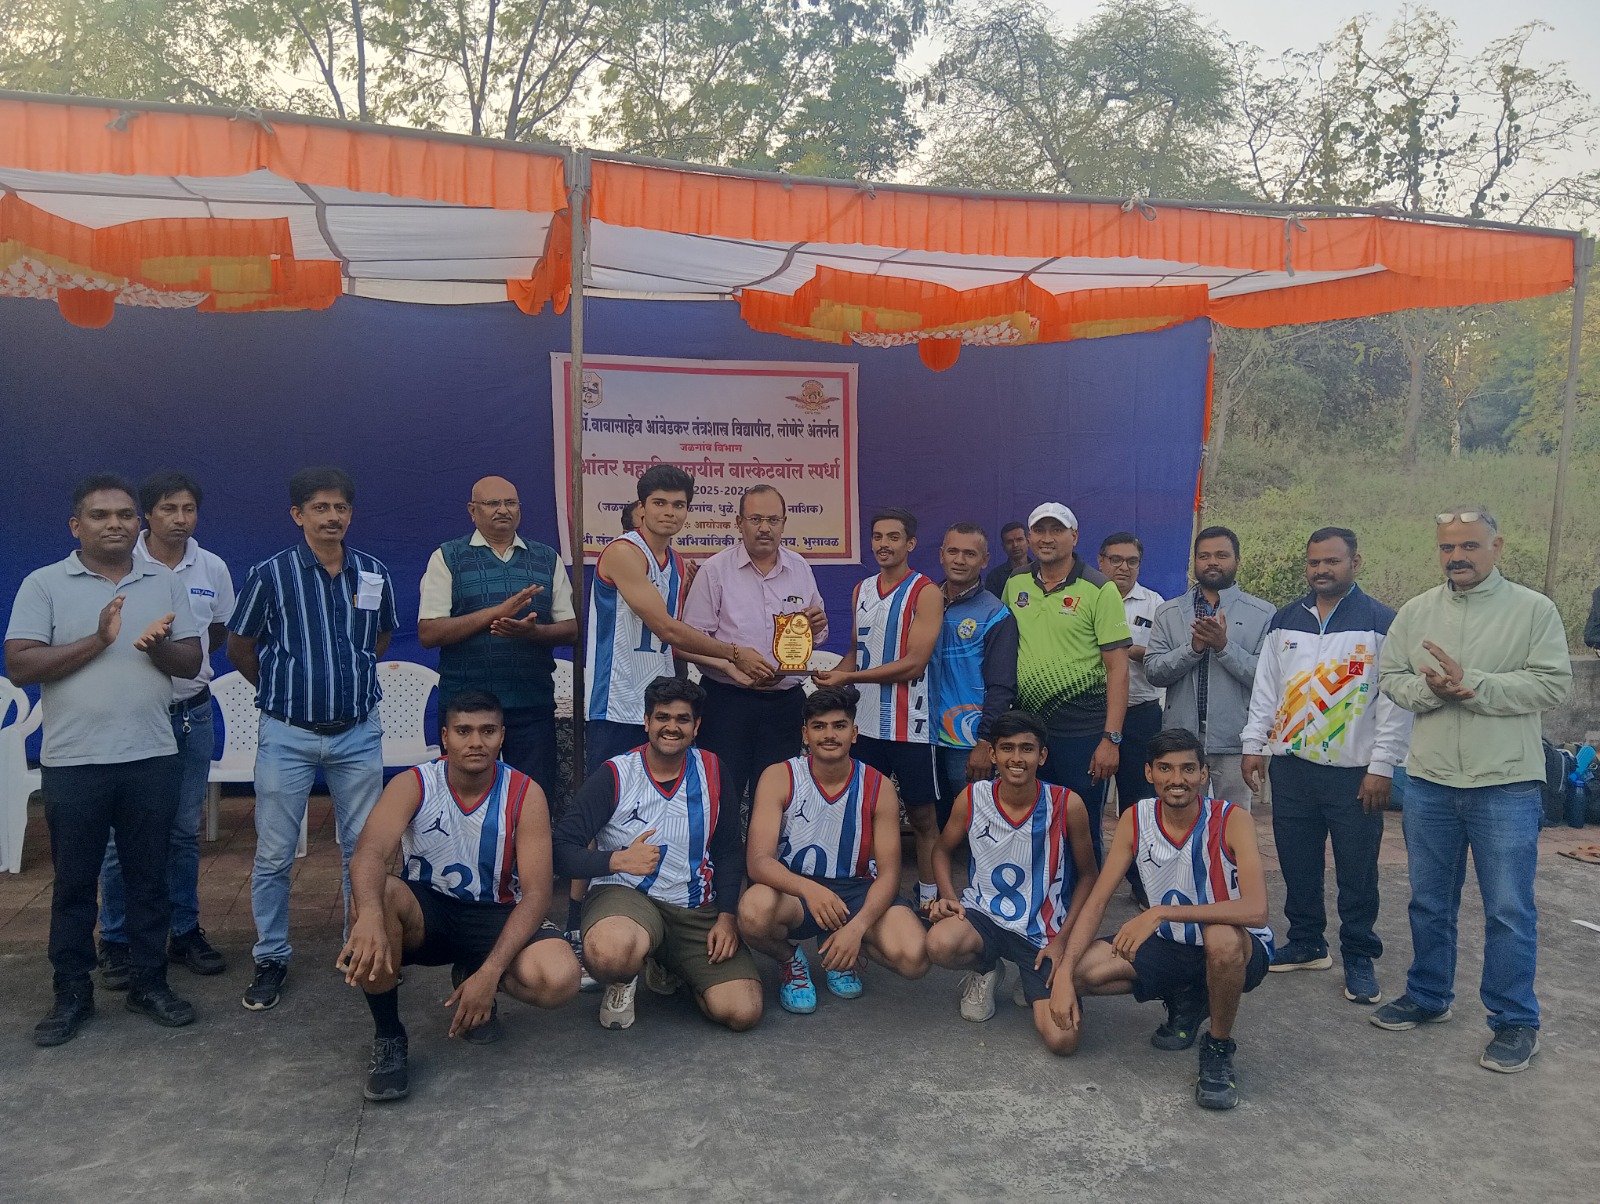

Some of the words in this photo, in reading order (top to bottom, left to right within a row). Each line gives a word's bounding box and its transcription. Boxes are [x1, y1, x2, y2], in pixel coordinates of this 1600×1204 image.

[646, 415, 690, 436] आंबेडकर
[776, 418, 804, 438] लोणेरे
[807, 419, 839, 439] अंतर्गत
[714, 441, 743, 453] विभाग
[728, 456, 804, 479] बास्केटबॉल
[807, 457, 840, 479] स्पर्धा
[694, 519, 732, 529] आयोजक
[676, 534, 735, 546] अभियांत्रिकी
[802, 536, 839, 550] भुसावळ
